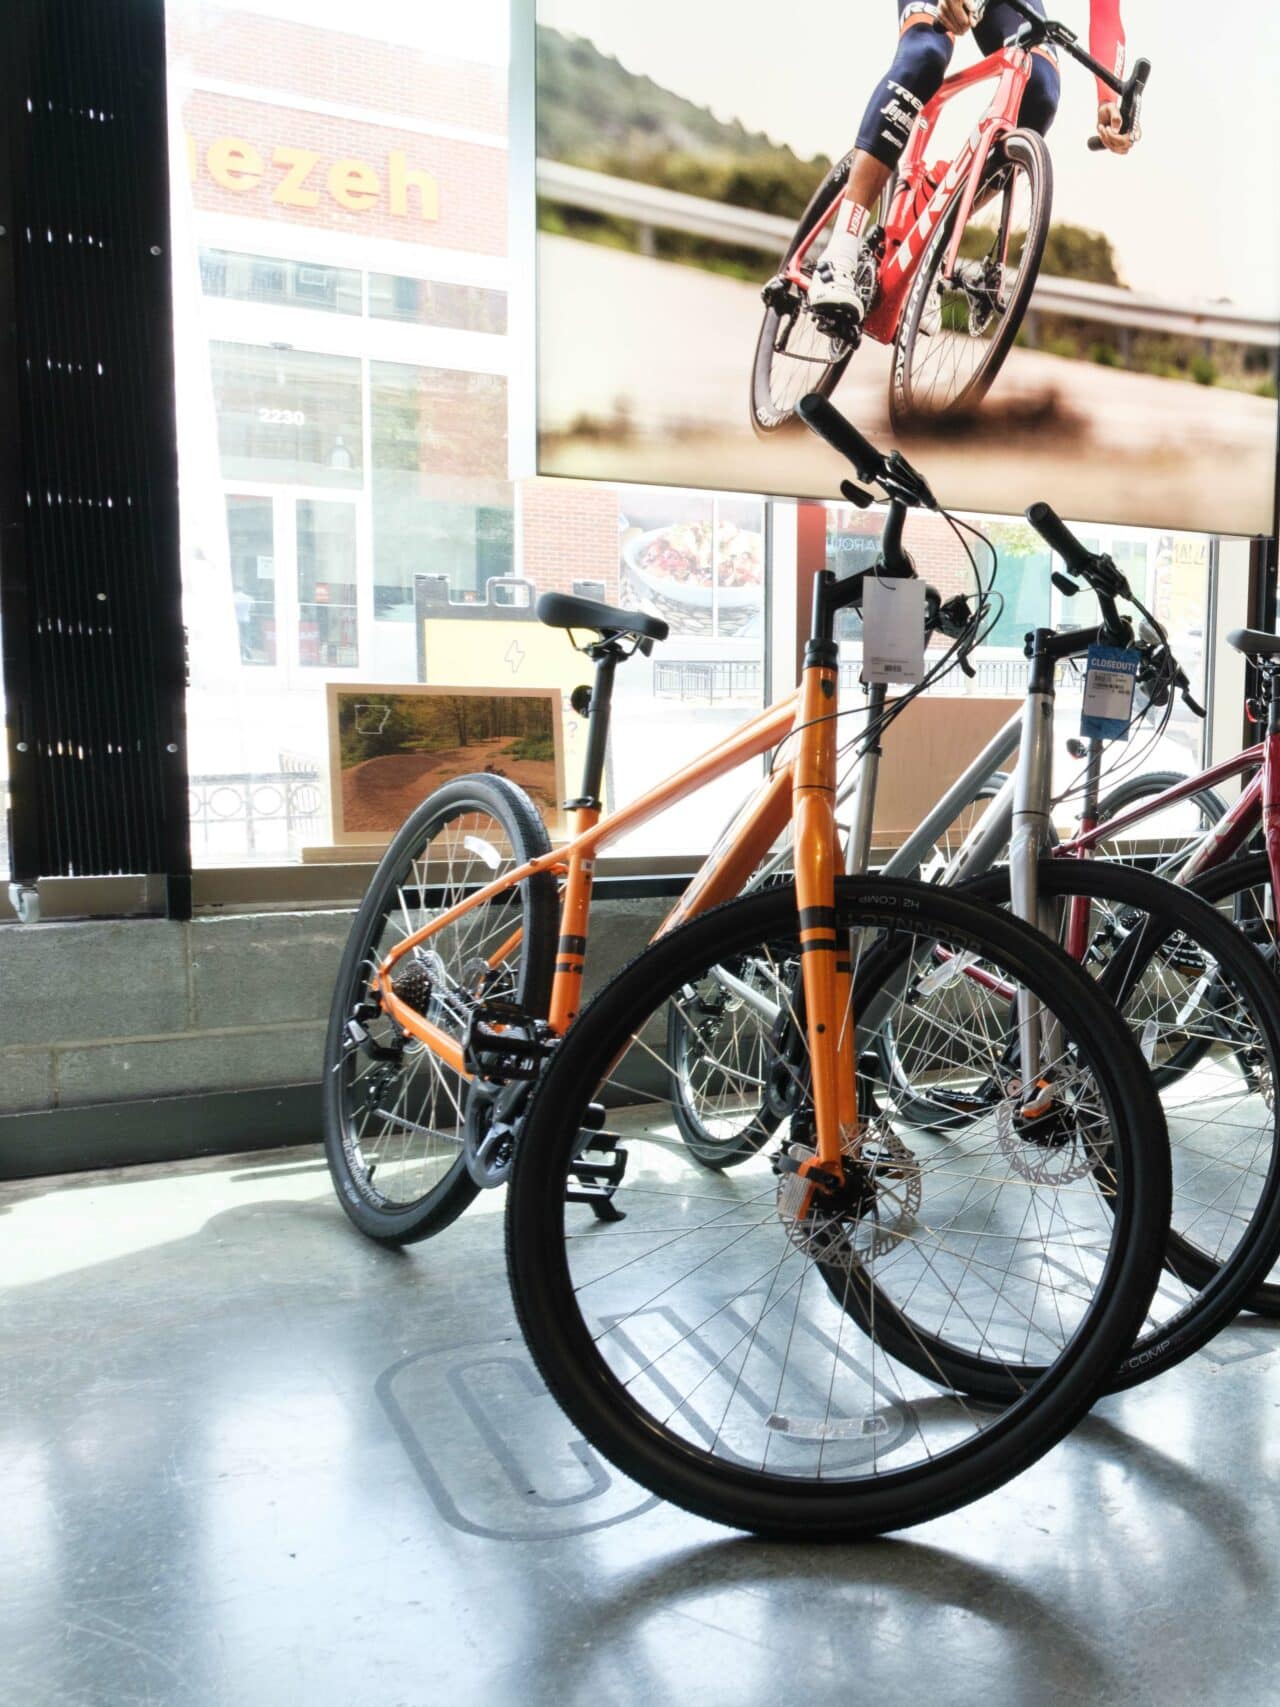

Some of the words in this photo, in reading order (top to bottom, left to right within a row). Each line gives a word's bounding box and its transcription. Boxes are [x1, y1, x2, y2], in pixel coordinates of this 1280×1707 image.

[886, 80, 925, 112] TRE
[259, 408, 304, 426] 2230
[1091, 657, 1136, 673] CLOSEOUT!
[903, 898, 920, 909] H2
[1128, 1340, 1171, 1369] COMP
